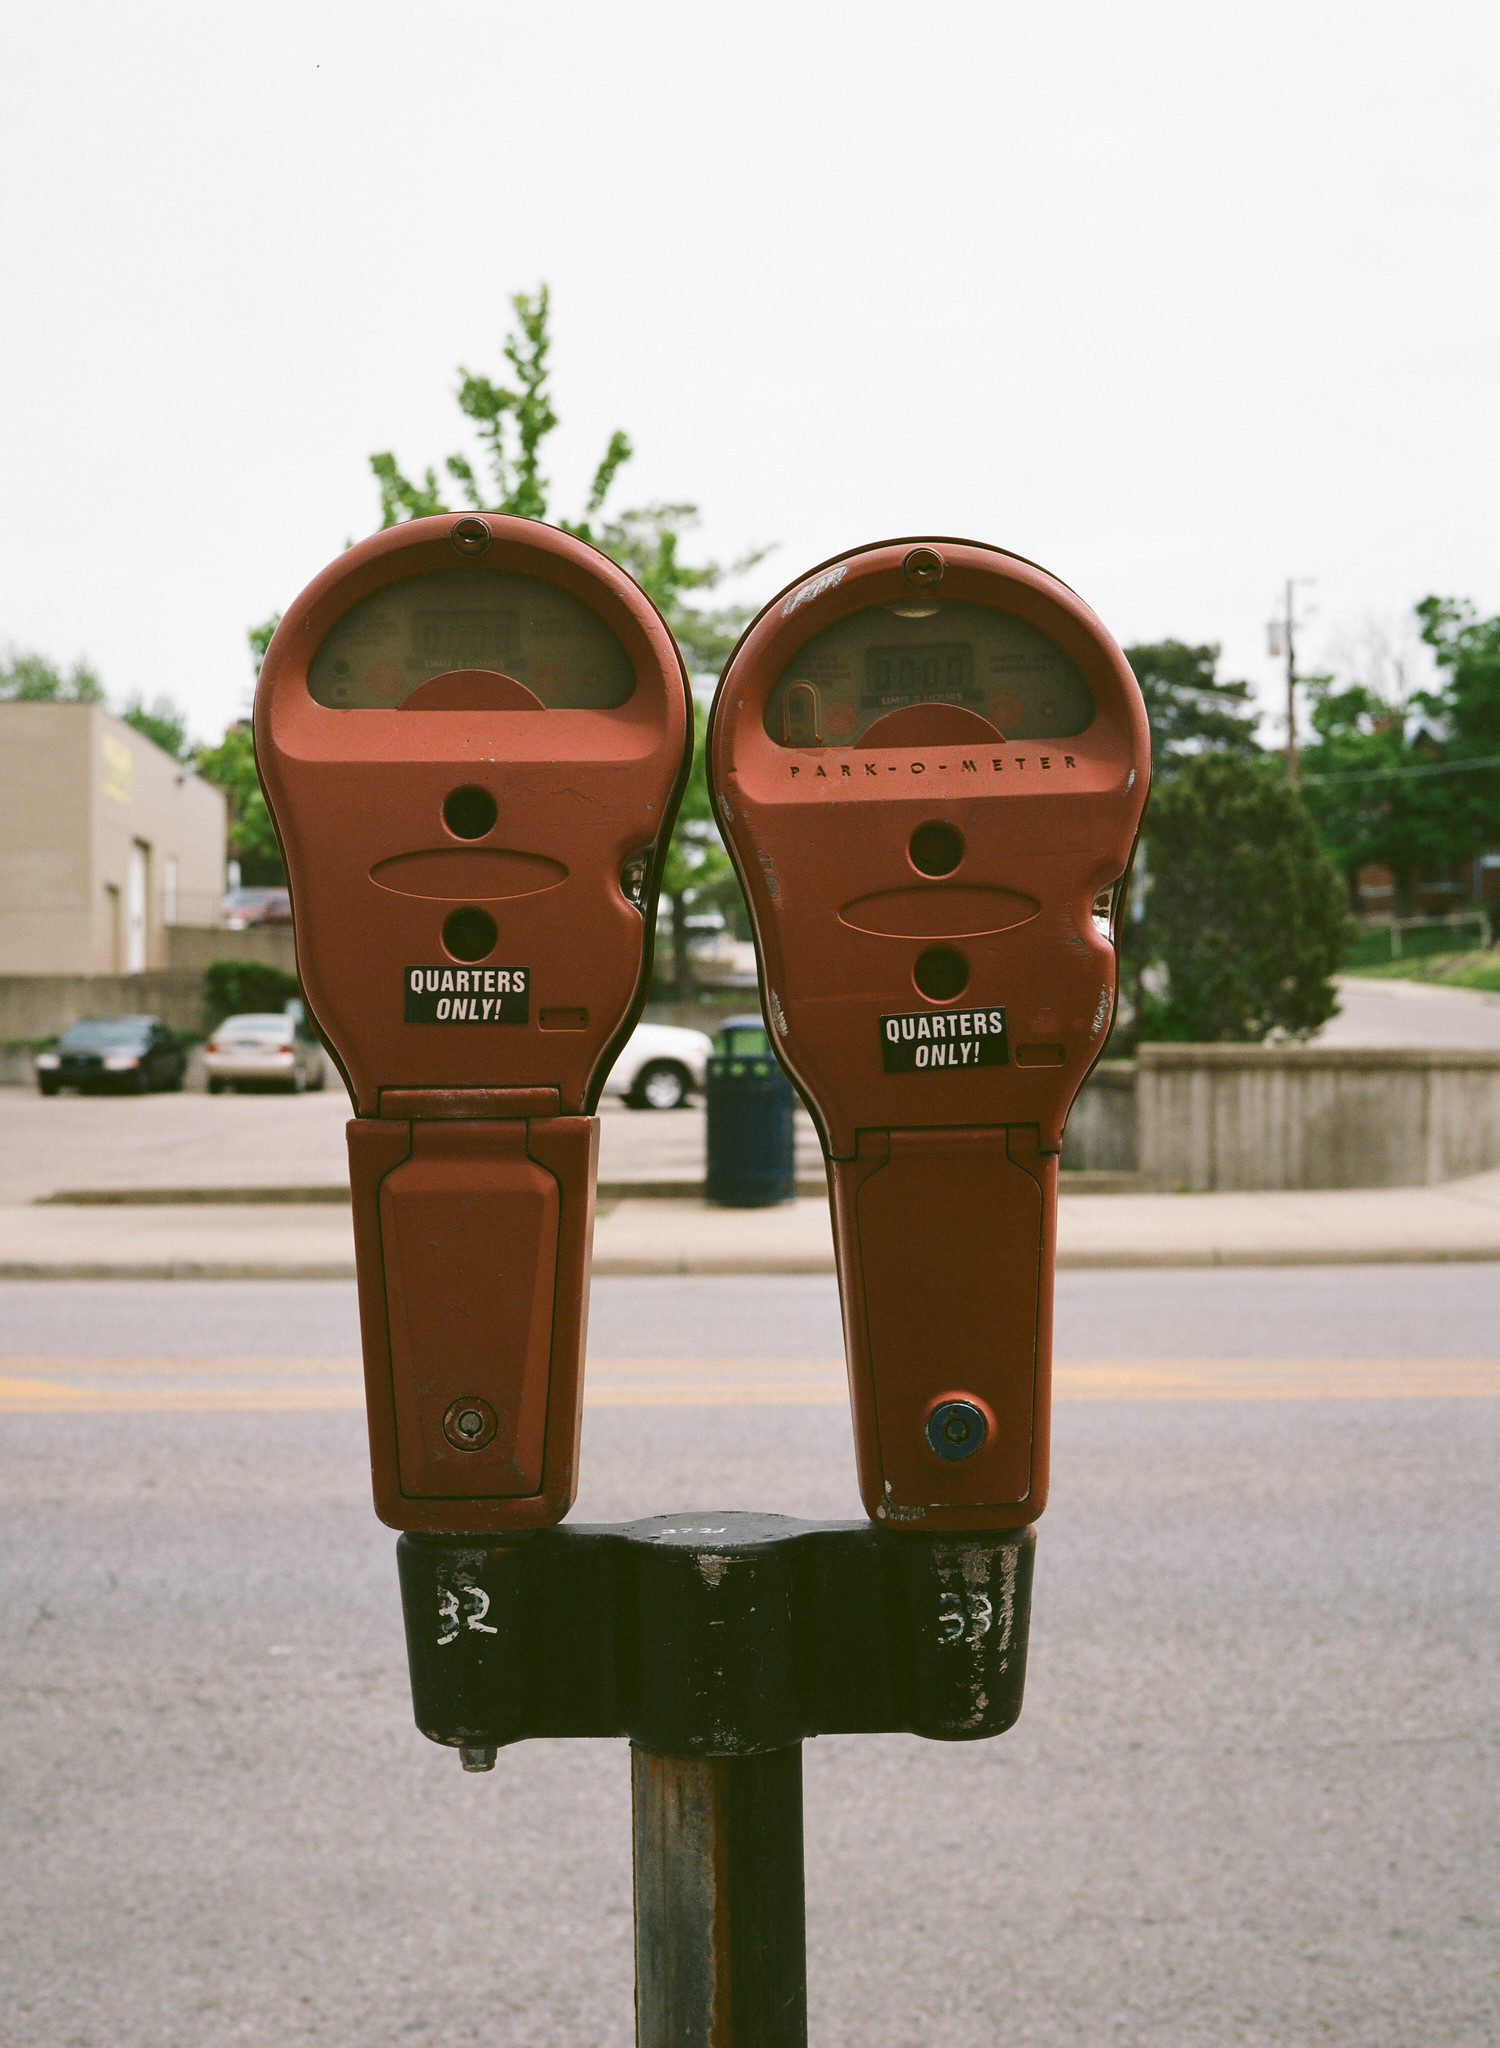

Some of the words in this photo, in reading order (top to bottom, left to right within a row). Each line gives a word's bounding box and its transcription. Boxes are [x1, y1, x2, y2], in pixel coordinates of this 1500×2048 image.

[881, 695, 910, 706] LIMIT
[924, 692, 963, 703] HOURS
[790, 755, 1077, 778] PARK-O-METER
[410, 969, 526, 994] QUARTERS
[436, 997, 502, 1020] ONLY!
[885, 1011, 1003, 1044] QUARTERS
[914, 1041, 980, 1068] ONLY!
